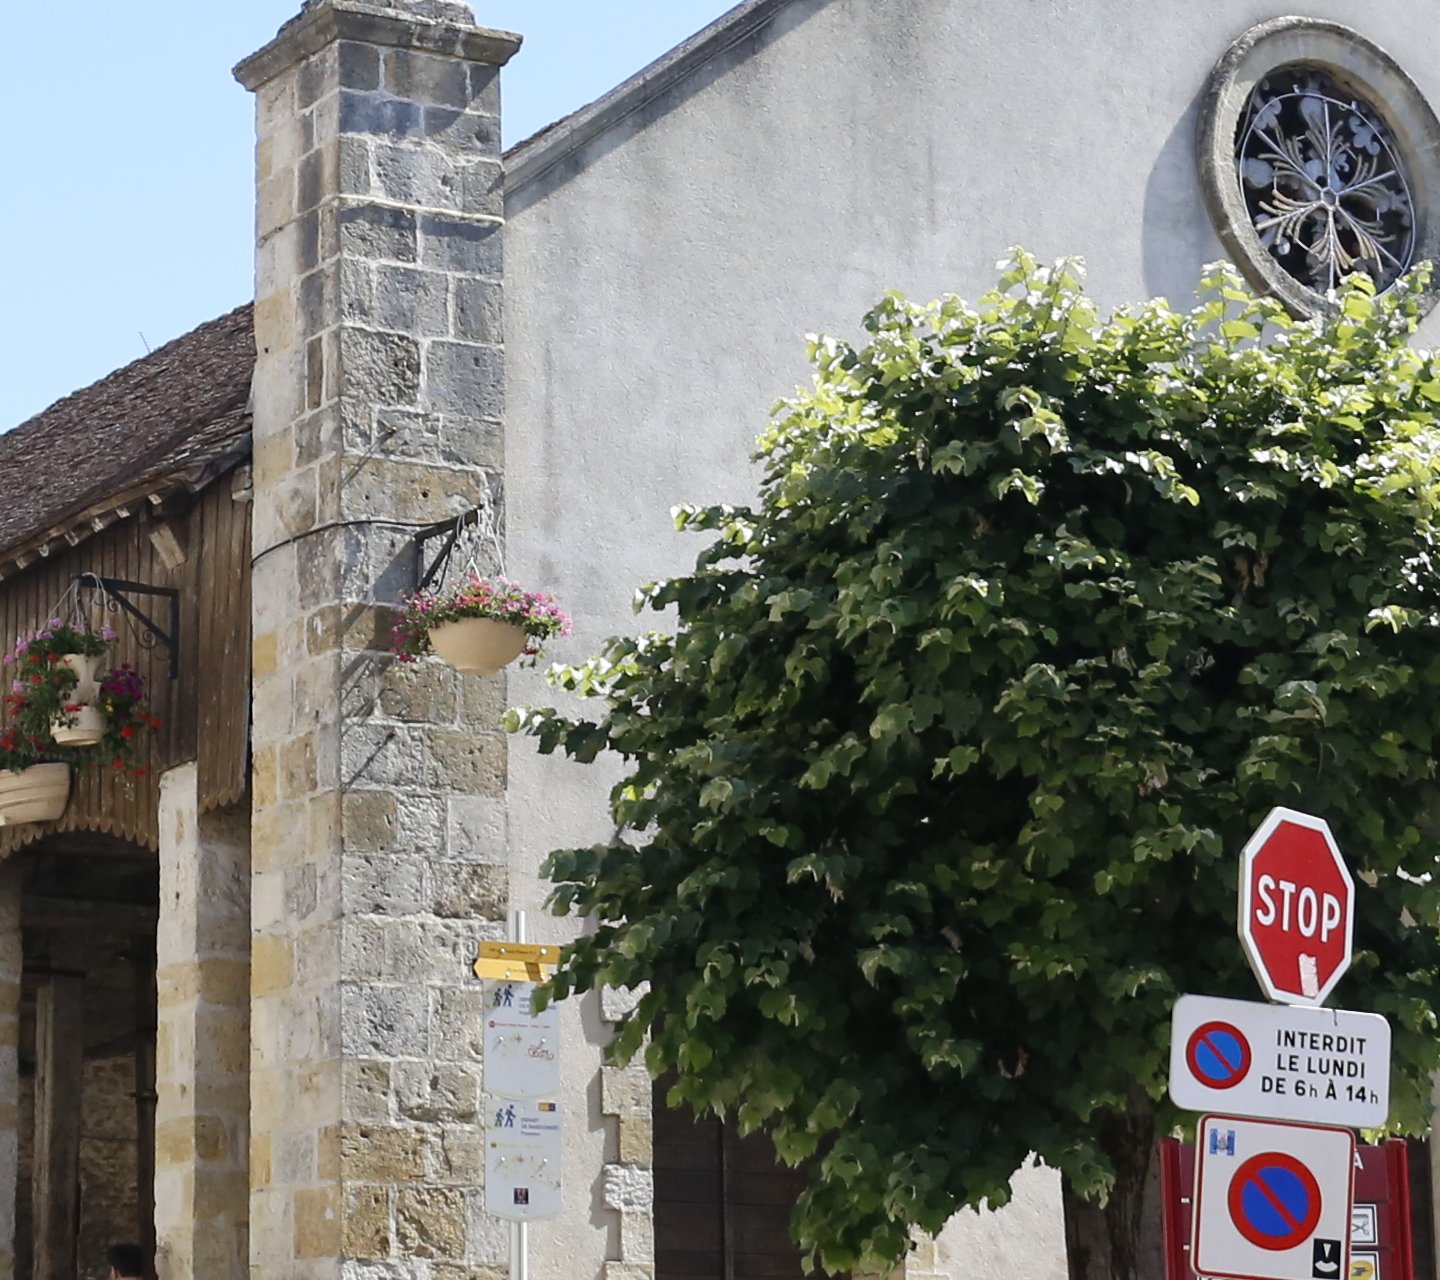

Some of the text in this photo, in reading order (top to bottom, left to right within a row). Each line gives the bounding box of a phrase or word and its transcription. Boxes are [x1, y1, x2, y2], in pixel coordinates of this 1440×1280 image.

[1255, 873, 1341, 943] STOP
[1276, 1029, 1367, 1055] INTERDIT
[1276, 1053, 1366, 1079] LE LUNDI
[1261, 1076, 1379, 1105] DE 6h À 14h
